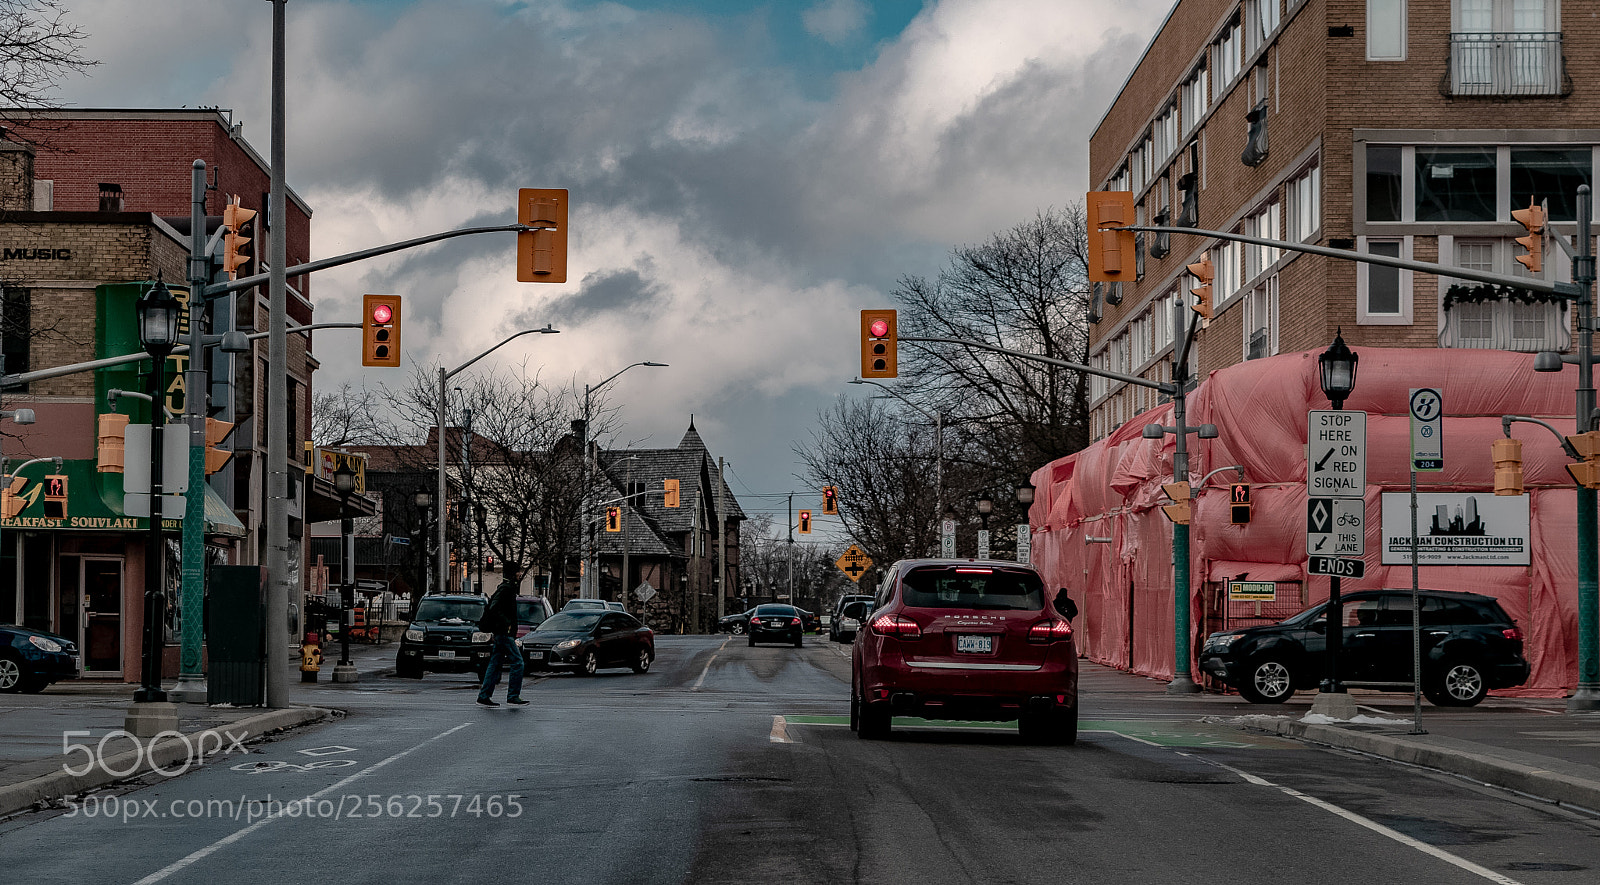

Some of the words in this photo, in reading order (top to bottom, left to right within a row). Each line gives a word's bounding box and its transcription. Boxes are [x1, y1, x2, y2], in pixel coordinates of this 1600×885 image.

[3, 247, 71, 260] MUSIC
[1320, 415, 1352, 426] STOP
[1319, 430, 1352, 441] HERE
[1341, 445, 1357, 456] ON
[1333, 461, 1357, 473] RED
[1420, 460, 1435, 468] 204
[1314, 477, 1358, 489] SIGNAL
[70, 516, 138, 529] SOUVLAKI
[1338, 534, 1357, 542] THIS
[1434, 537, 1506, 545] CONSTRUCTION
[1508, 537, 1523, 545] LTD
[1335, 543, 1358, 551] LANE
[1318, 558, 1355, 575] ENDS
[1242, 583, 1274, 592] MODU-LOC
[958, 639, 975, 649] CAWW
[978, 640, 991, 649] 819
